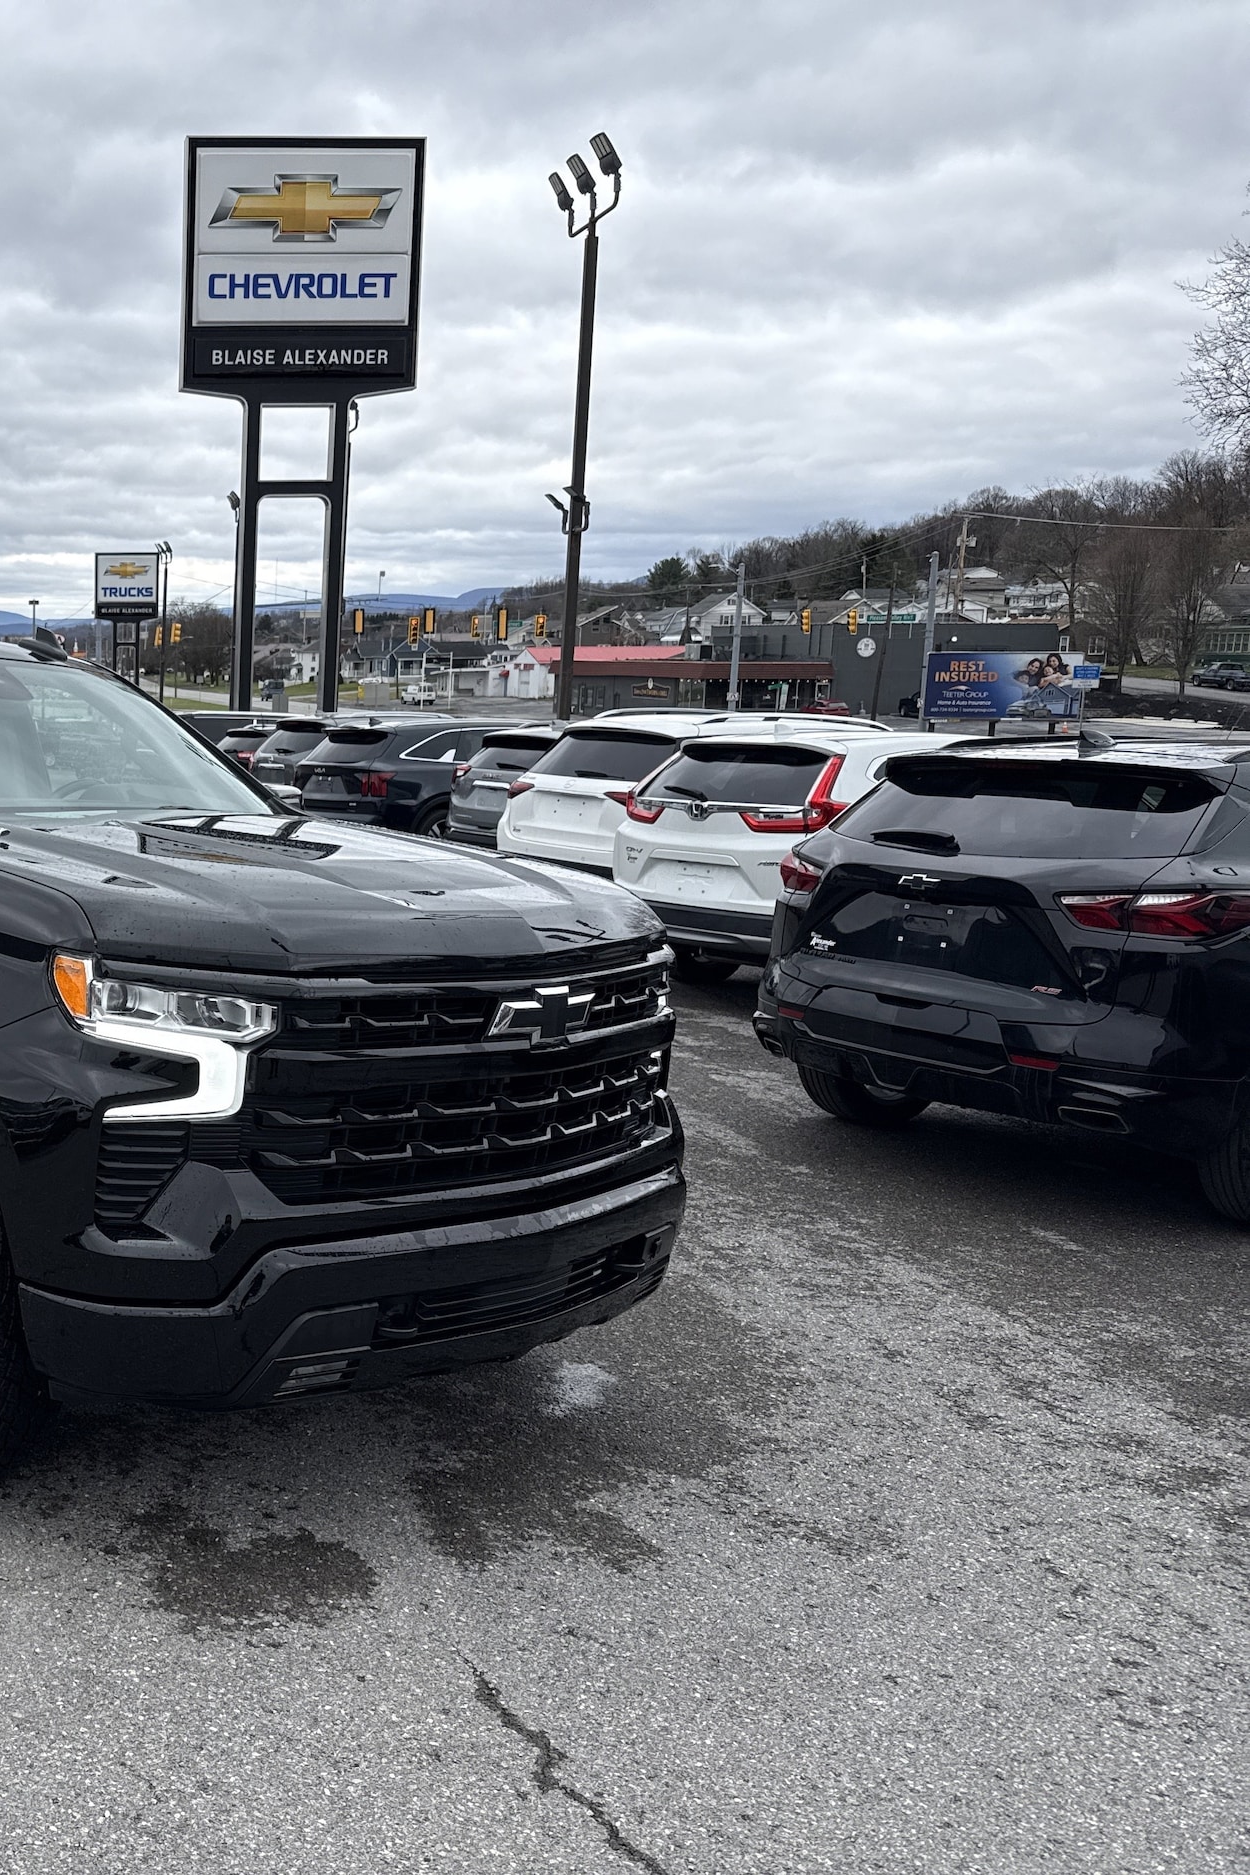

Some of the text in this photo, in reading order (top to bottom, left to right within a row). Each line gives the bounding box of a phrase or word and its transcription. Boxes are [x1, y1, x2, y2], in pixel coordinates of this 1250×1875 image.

[208, 273, 398, 299] CHEVROLET
[211, 349, 389, 365] BLAISE ALEXANDER
[101, 586, 154, 597] TRUCKS
[949, 660, 986, 672] REST
[934, 671, 999, 683] INSURED
